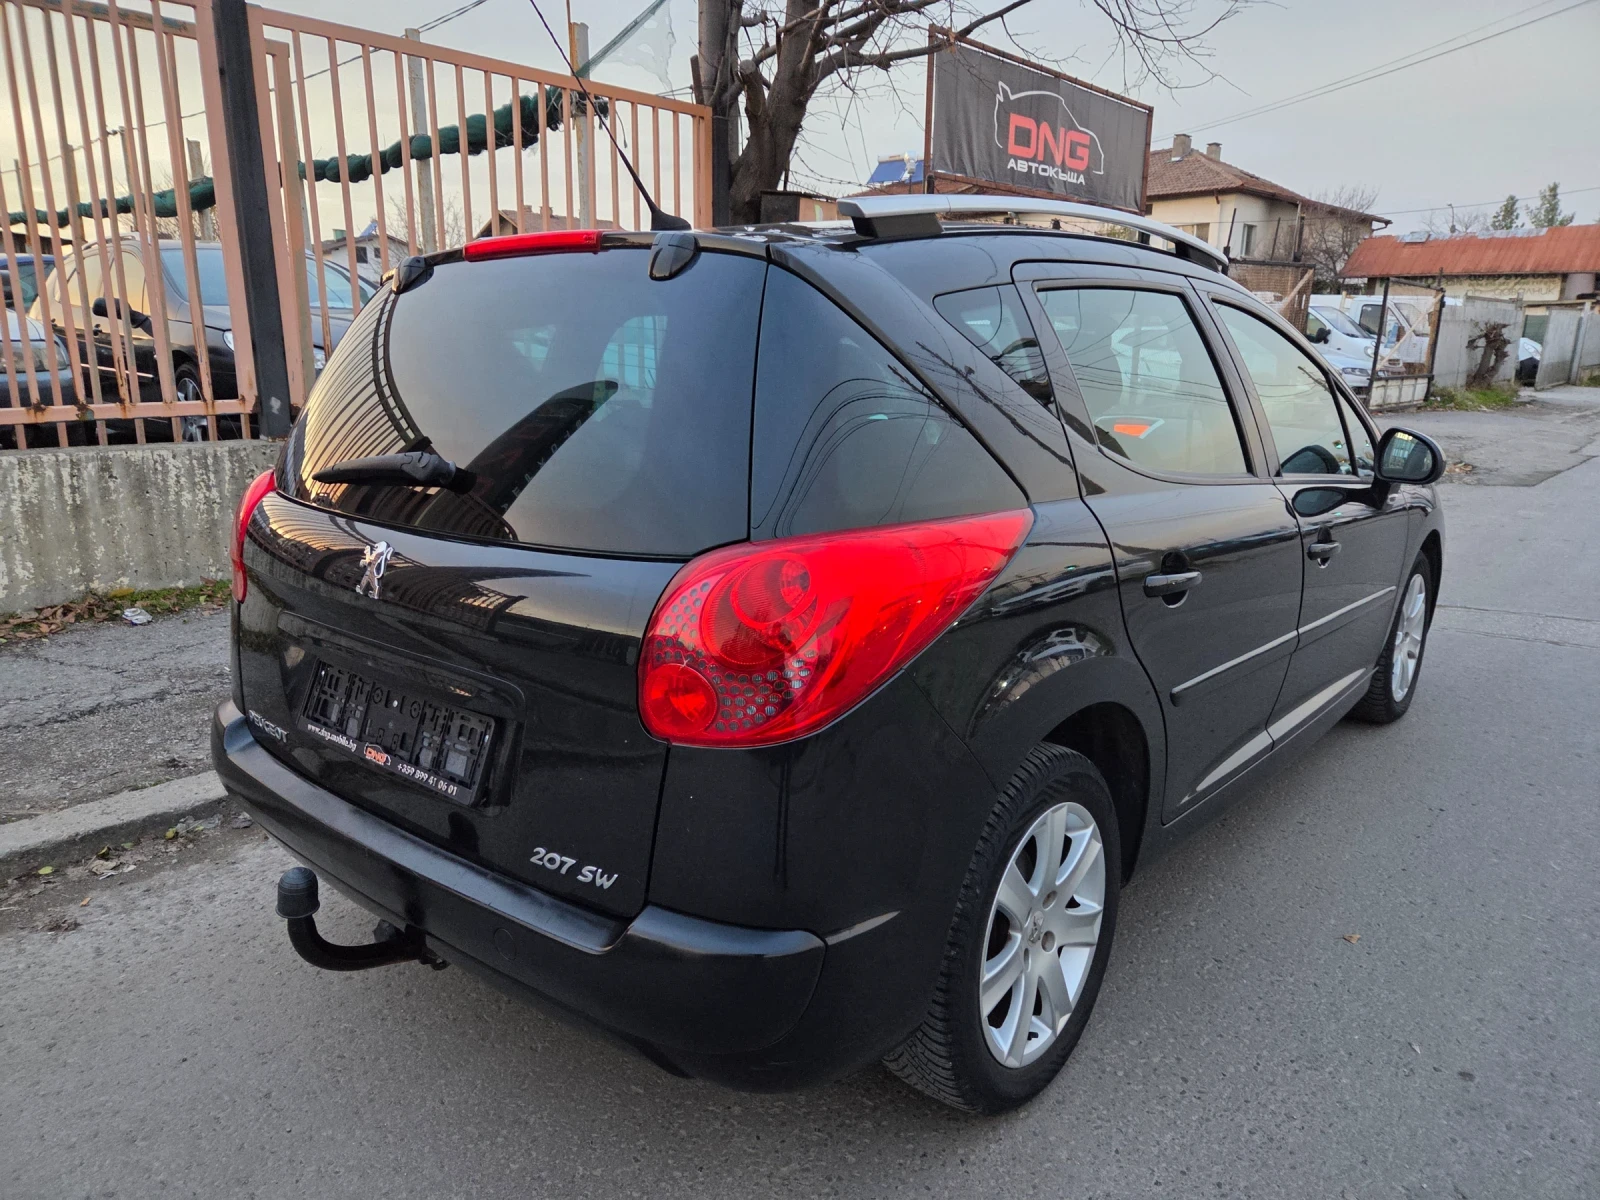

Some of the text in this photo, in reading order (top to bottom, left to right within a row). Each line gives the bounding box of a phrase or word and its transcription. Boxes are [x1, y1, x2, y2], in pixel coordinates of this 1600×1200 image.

[1008, 112, 1091, 171] DNG
[248, 709, 289, 743] PEUGEOT
[397, 763, 458, 796] +359 899 41 06 01
[530, 847, 619, 890] 207 SW
